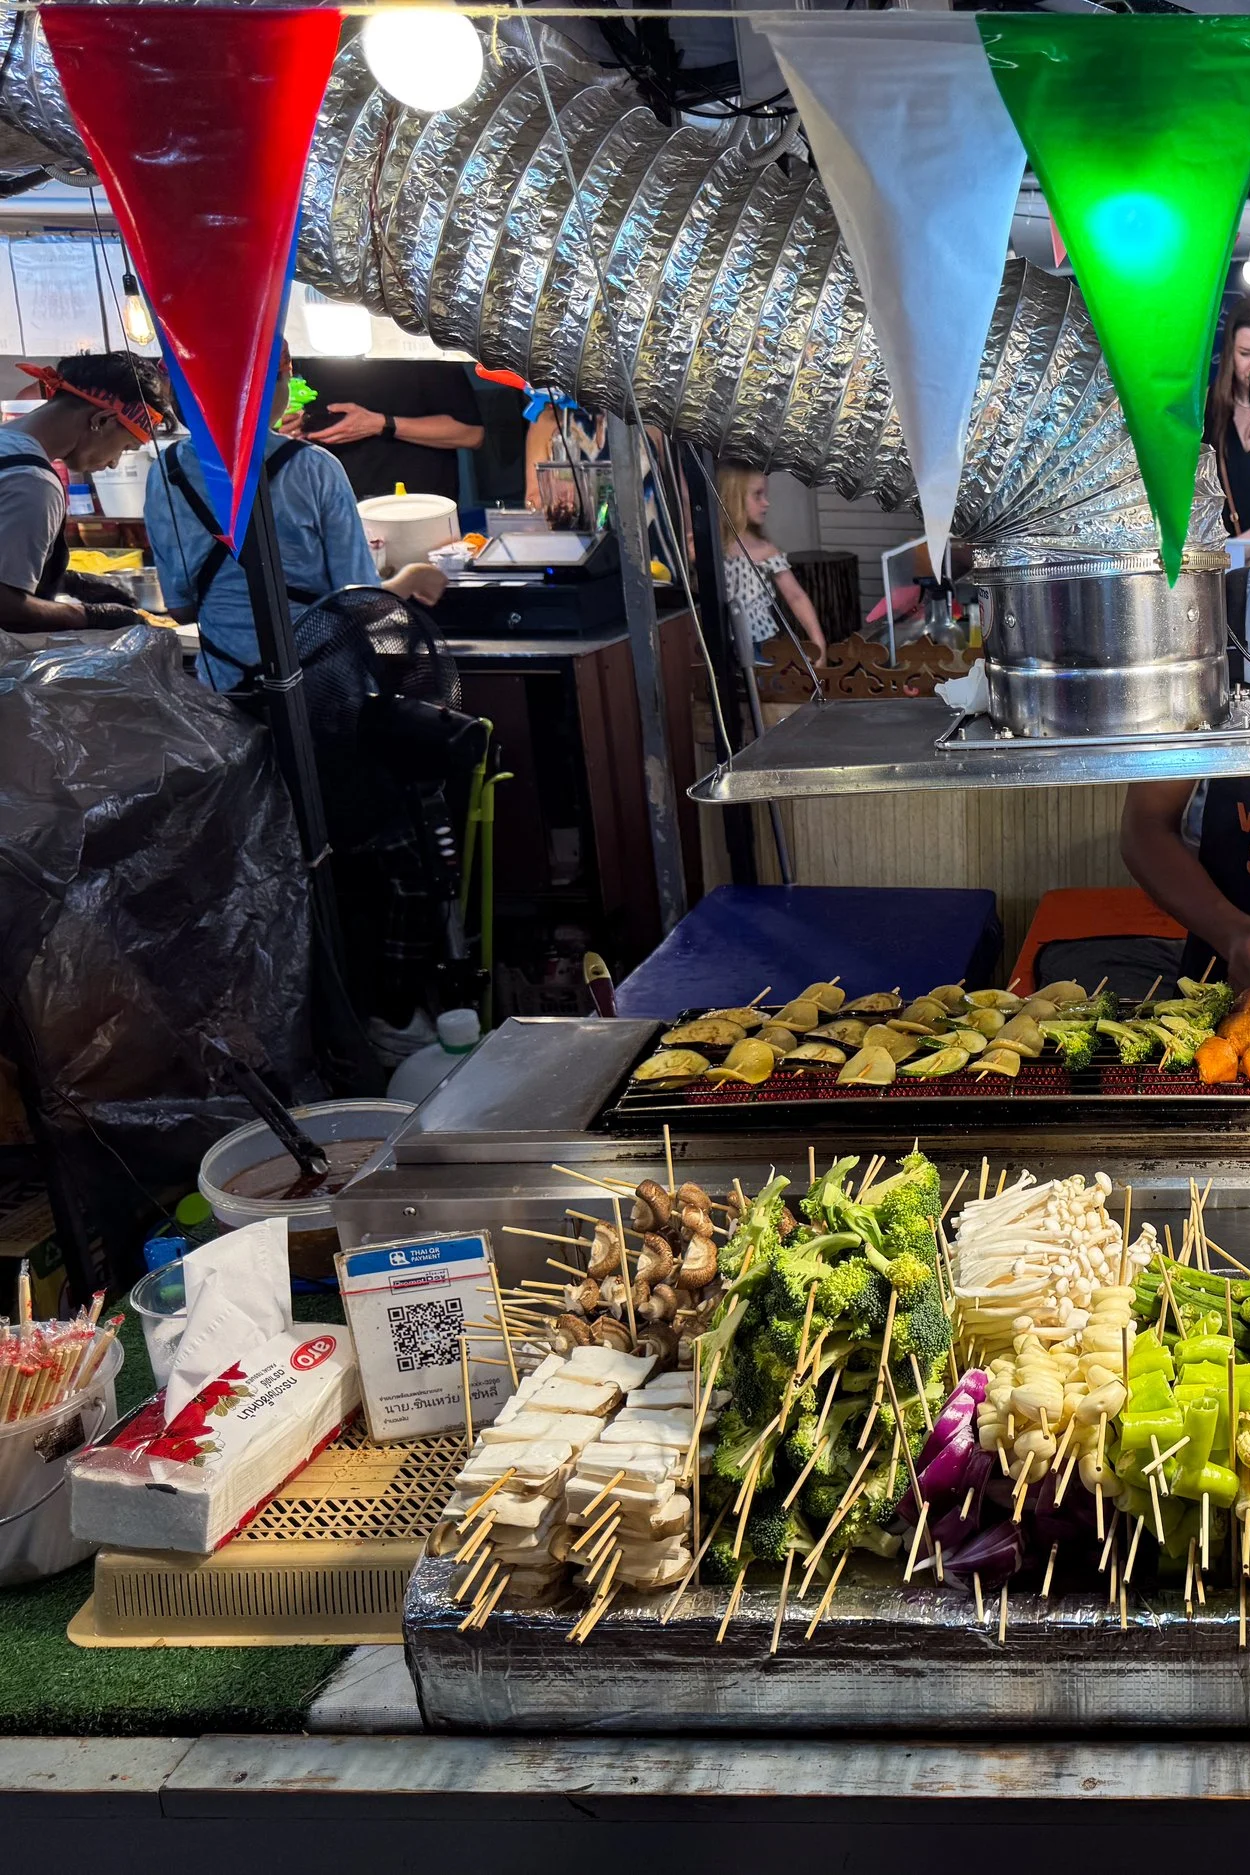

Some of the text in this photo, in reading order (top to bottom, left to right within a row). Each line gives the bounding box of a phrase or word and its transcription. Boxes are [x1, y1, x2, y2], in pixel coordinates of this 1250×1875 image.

[410, 1248, 428, 1257] THAI
[411, 1252, 441, 1262] PAYMENT
[296, 1341, 331, 1367] aro
[237, 1376, 298, 1420] กระดาษเช็ดหน้า
